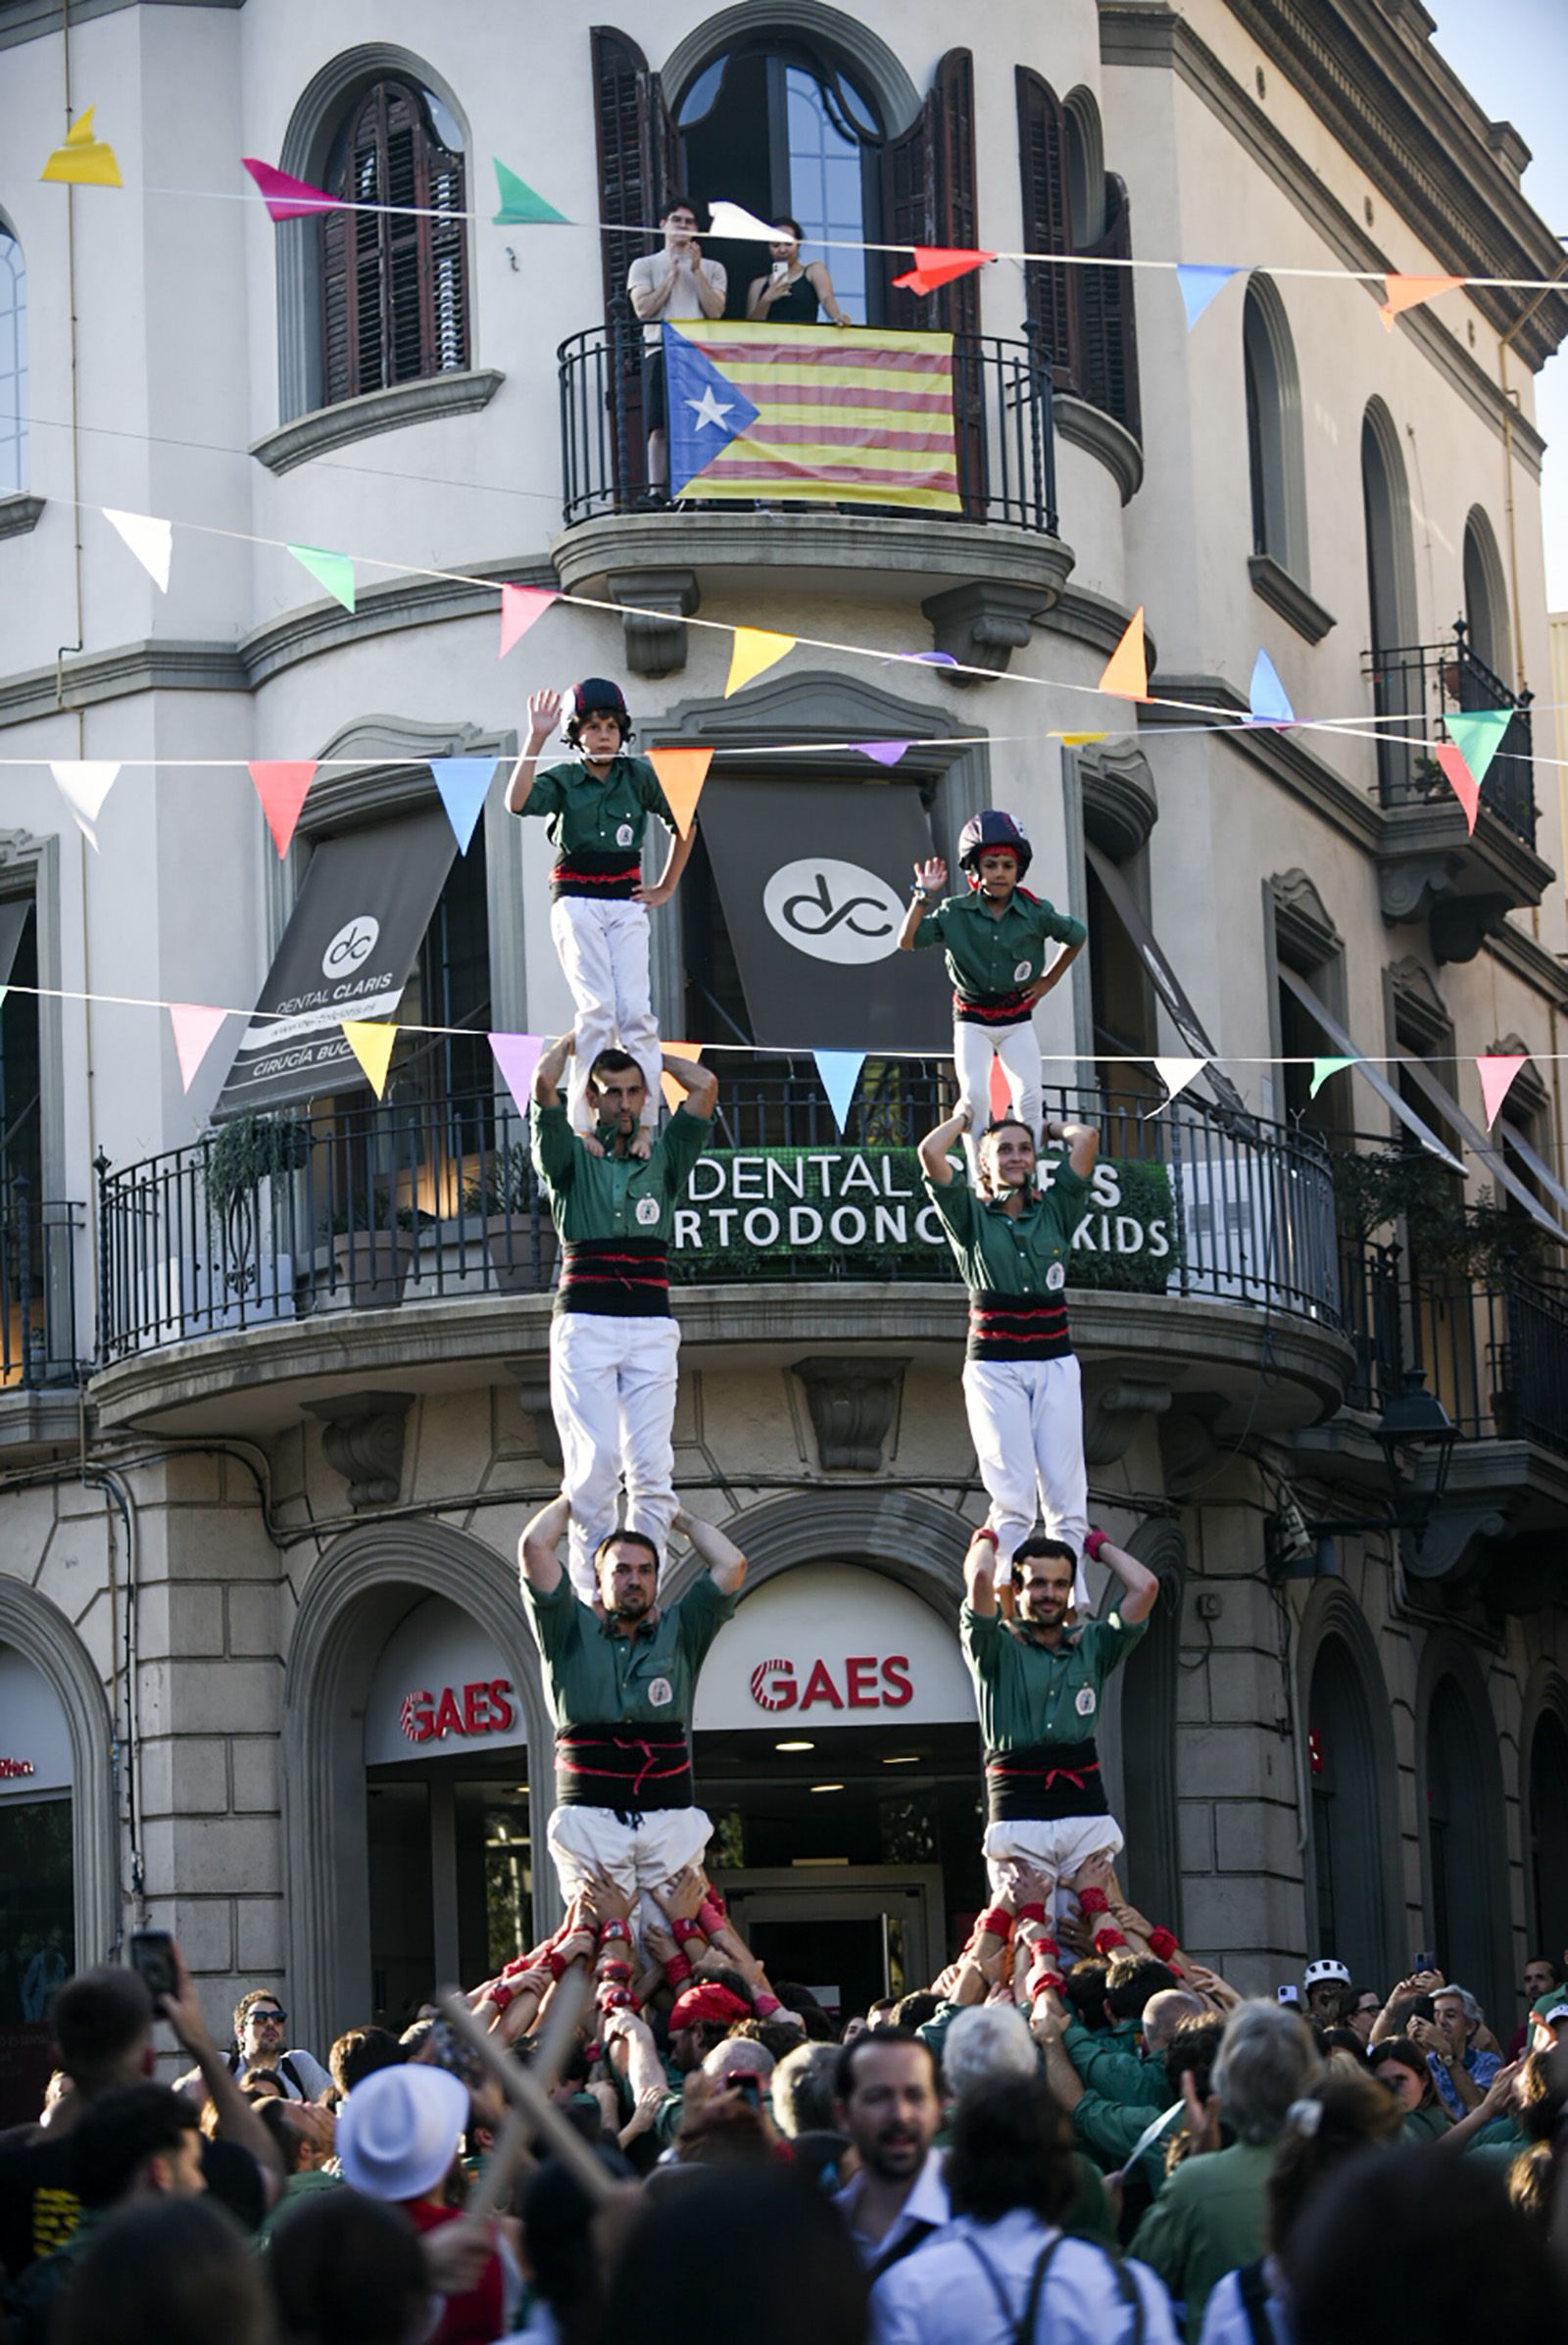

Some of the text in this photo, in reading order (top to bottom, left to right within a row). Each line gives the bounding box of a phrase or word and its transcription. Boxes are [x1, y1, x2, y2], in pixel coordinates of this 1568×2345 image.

[274, 972, 392, 1014] DENTAL CLARIS
[317, 1042, 352, 1060] BUC
[688, 1153, 913, 1201] DENTAL
[673, 1205, 1170, 1257] RTODONC KIDS
[751, 1655, 915, 1711] GAES
[400, 1678, 514, 1742] GAES
